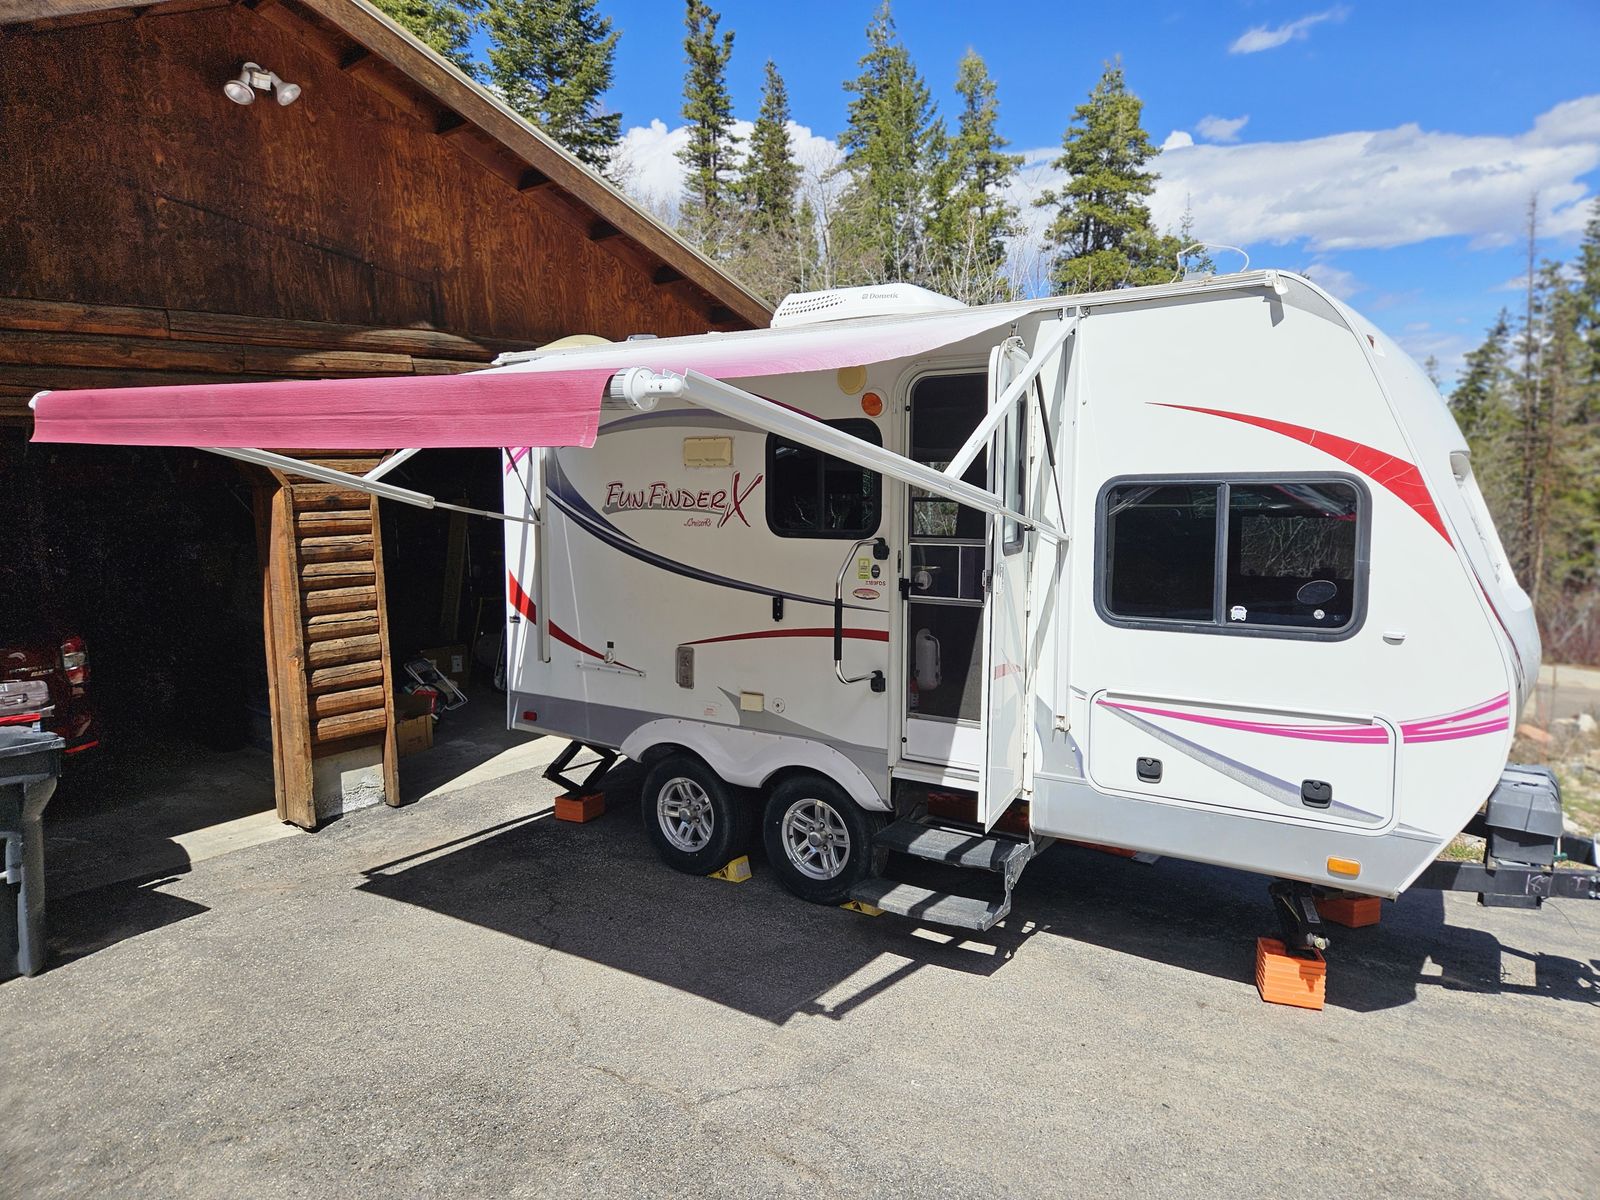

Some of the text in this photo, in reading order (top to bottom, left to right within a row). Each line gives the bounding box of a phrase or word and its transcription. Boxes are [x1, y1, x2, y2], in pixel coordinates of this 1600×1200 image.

[869, 292, 899, 300] Dometic
[605, 482, 644, 509] FUN
[718, 471, 764, 528] X
